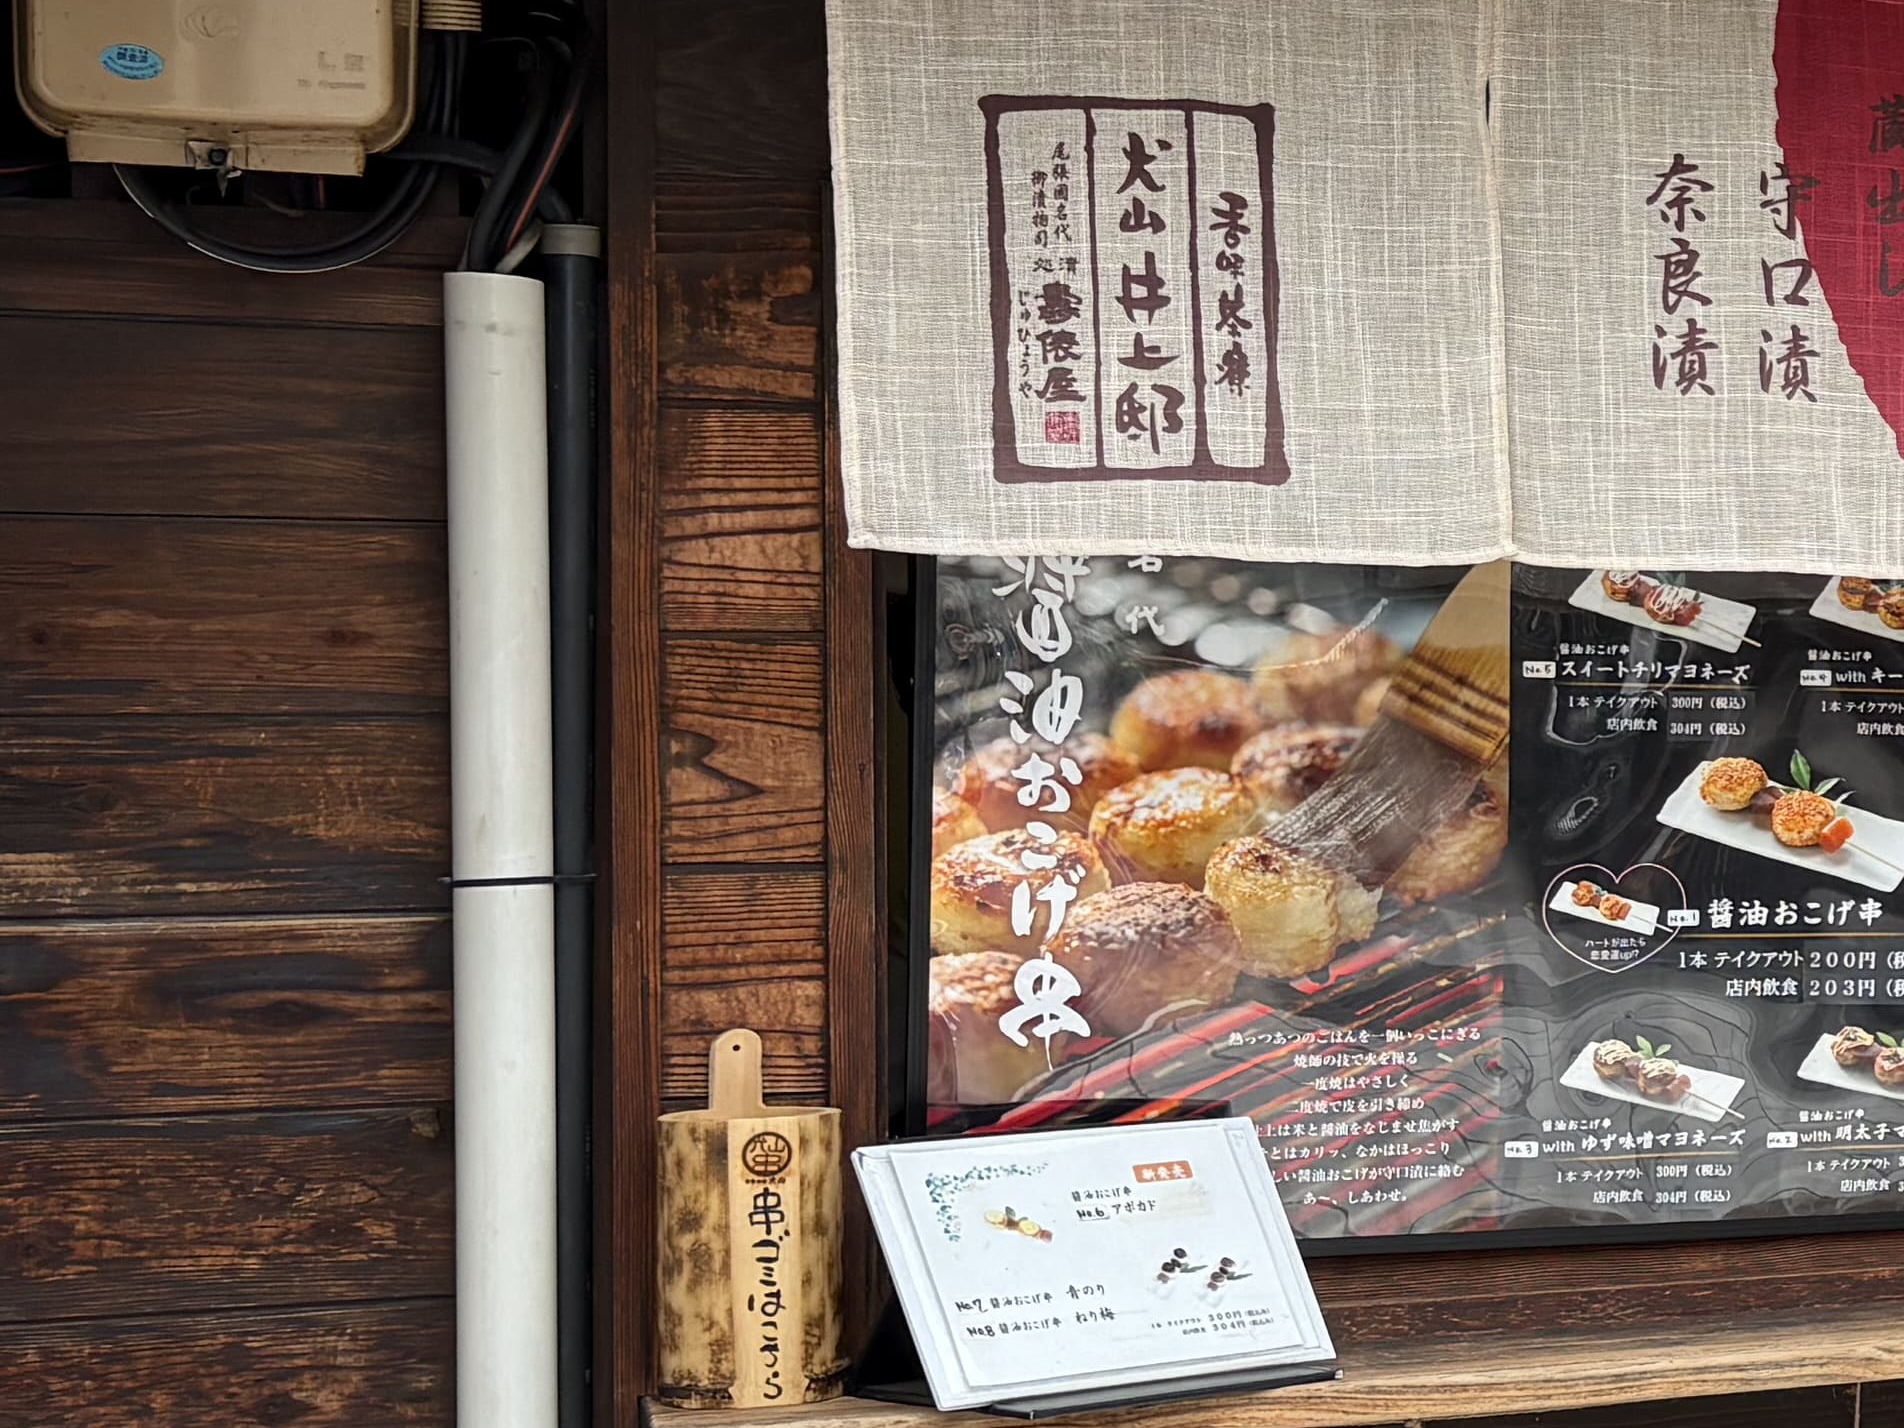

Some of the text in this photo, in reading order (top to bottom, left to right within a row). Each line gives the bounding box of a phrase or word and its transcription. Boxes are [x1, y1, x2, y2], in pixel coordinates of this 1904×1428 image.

[1645, 152, 1720, 398] 奈良漬
[1757, 162, 1822, 404] 守口漬
[1114, 131, 1187, 456] 犬山井上邸
[1017, 289, 1033, 400] じゅひょうや
[1557, 641, 1631, 659] 醤油おこげ串
[1806, 648, 1873, 663] 醤油おこげ串
[1560, 659, 1752, 684] スイートチリマヨネーズ
[1835, 668, 1867, 685] with
[1592, 694, 1660, 710] テイクアウト
[1670, 696, 1703, 710] 300円
[1605, 716, 1659, 733] 店内飲食
[1707, 897, 1884, 930] 醤油おこげ串
[1583, 936, 1648, 951] ハートが出たら
[1679, 950, 1708, 969] 1本
[1713, 948, 1805, 971] テイクアウト
[1724, 977, 1798, 1000] 店内飲食
[1300, 1073, 1412, 1092] 一度焼はやさしく
[1797, 1107, 1866, 1124] 醤油おこげ串
[1541, 1117, 1613, 1134] 醤油おこげ串
[1541, 1138, 1577, 1155] with
[1579, 1127, 1747, 1152] ゆず味噌マヨネーズ
[1799, 1127, 1833, 1146] with
[1140, 1162, 1190, 1182] 新発売
[1828, 1155, 1892, 1172] テイクアウト
[1578, 1165, 1644, 1183] テイクアウト
[1070, 1185, 1134, 1204] 醤油おこげ串
[1838, 1176, 1892, 1194] 店内飲食
[1592, 1187, 1645, 1205] 店内飲食
[1110, 1198, 1158, 1217] アボカド
[746, 1186, 793, 1402] 串ゴミはこちら
[989, 1290, 1054, 1310] 醤油おこげ串
[1065, 1282, 1107, 1302] 青のり
[997, 1316, 1063, 1337] 醤油おこげ串
[1074, 1307, 1117, 1326] ねり梅
[1207, 1309, 1243, 1323] 300円
